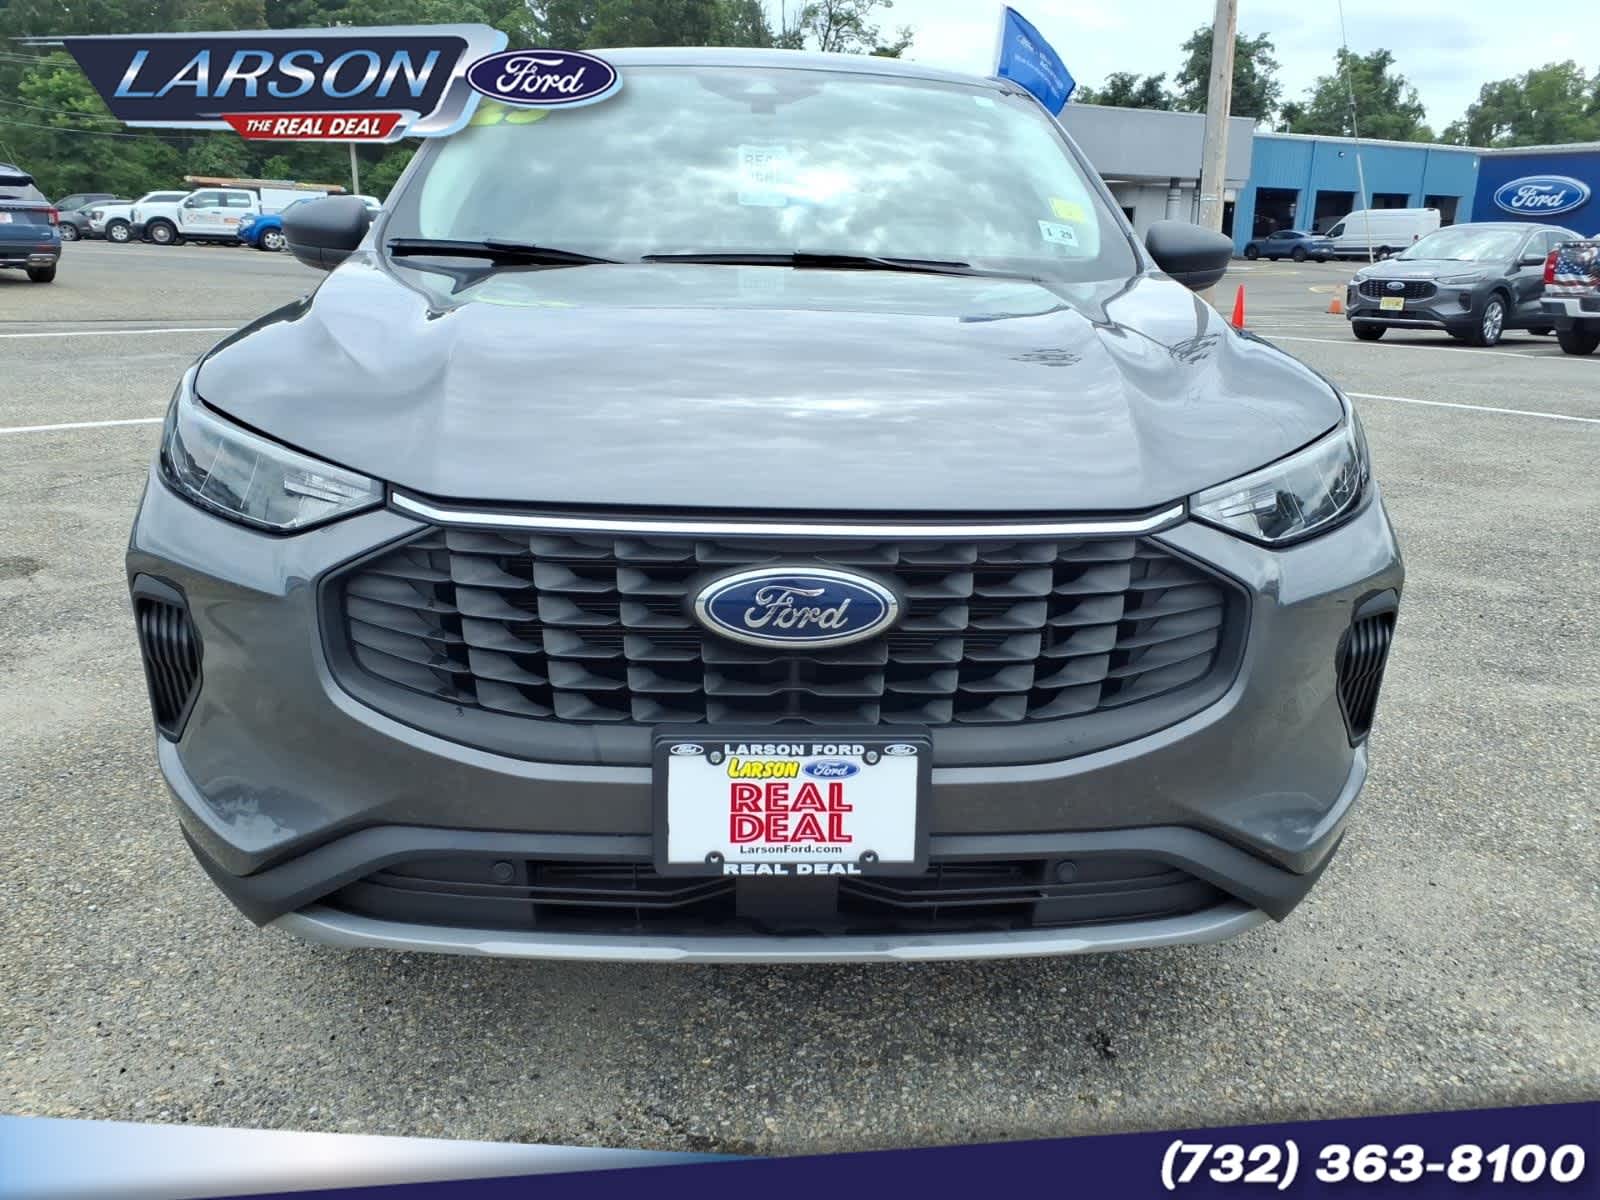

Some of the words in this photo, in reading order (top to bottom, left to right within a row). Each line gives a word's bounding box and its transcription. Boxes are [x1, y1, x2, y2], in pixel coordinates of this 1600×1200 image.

[1511, 185, 1567, 207] Ford
[744, 585, 852, 629] Ford
[724, 743, 805, 756] LARSON
[812, 743, 865, 756] FORD
[727, 757, 801, 780] LARSON
[812, 761, 849, 776] Ford
[729, 782, 854, 813] REAL
[729, 813, 854, 844] DEAL
[740, 844, 843, 855] LarsonFord.com
[722, 863, 789, 875] REAL
[796, 863, 862, 875] DEAL
